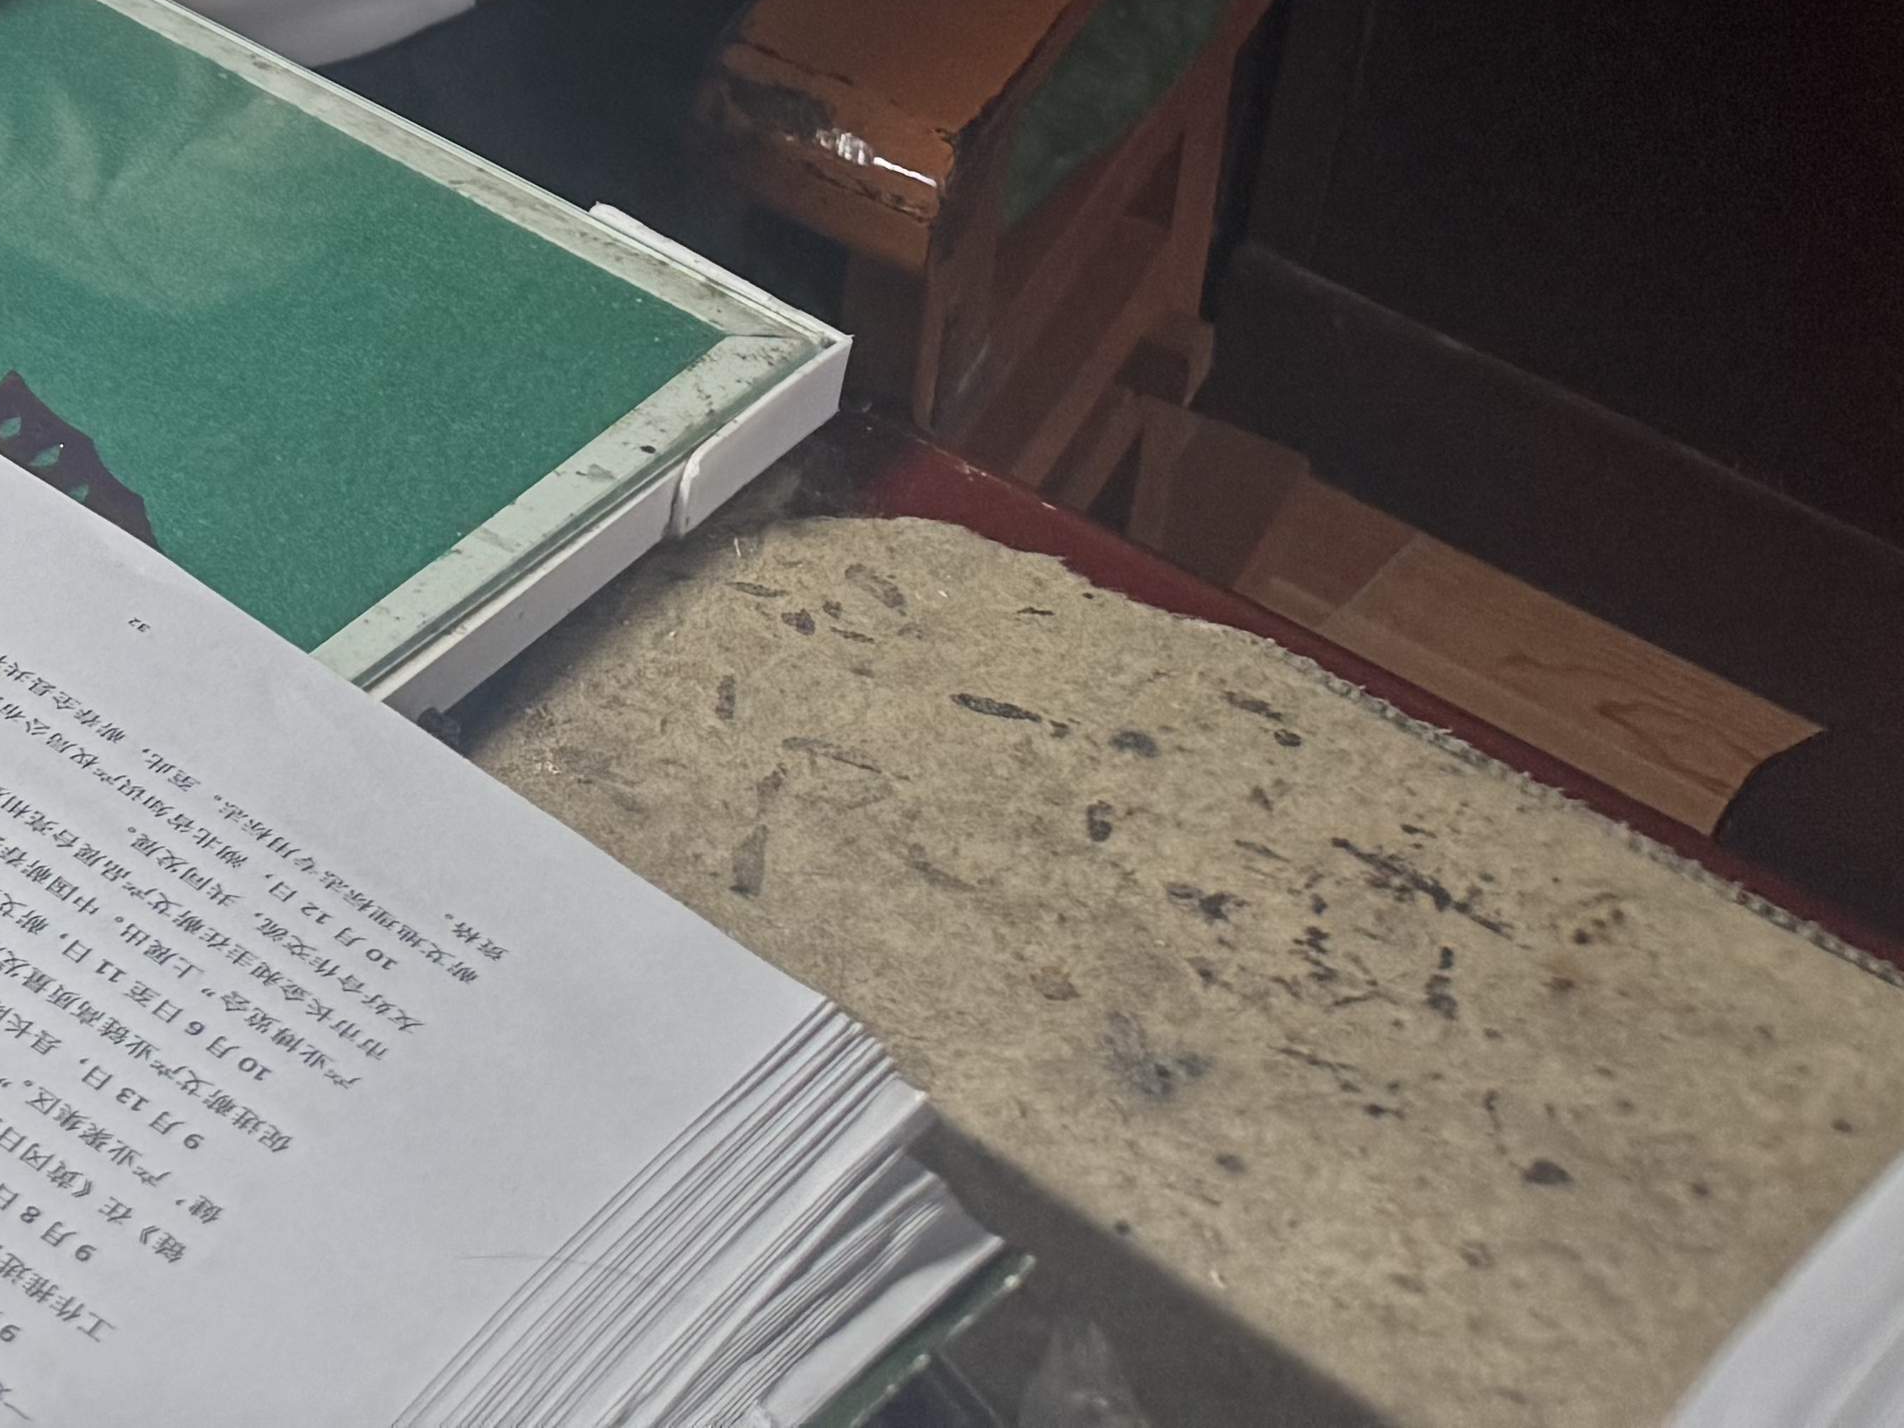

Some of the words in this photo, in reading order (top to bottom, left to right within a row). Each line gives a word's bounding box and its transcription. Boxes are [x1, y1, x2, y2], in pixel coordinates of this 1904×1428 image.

[115, 826, 424, 1037] 友好合作交流，共同发展。
[434, 910, 511, 964] 资格。
